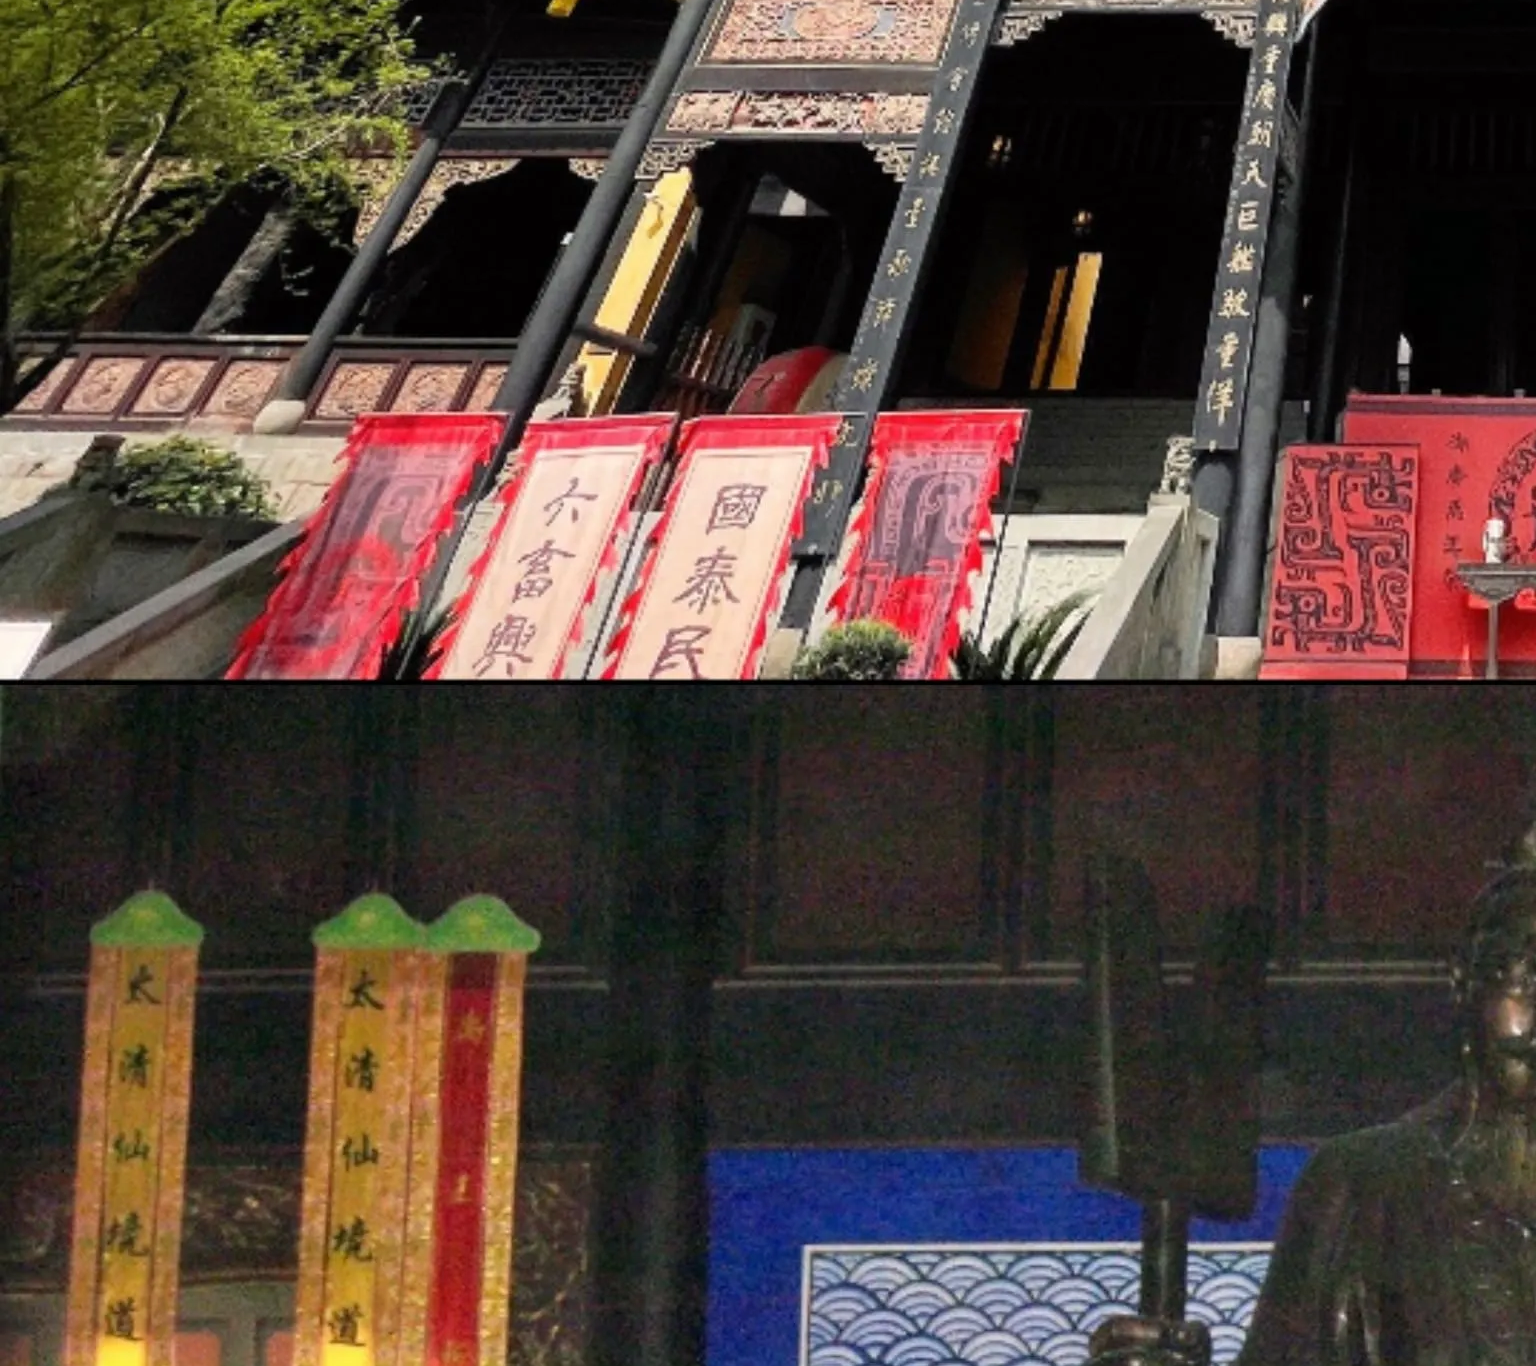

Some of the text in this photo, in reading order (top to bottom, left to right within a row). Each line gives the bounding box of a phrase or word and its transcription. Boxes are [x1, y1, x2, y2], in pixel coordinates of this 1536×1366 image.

[472, 476, 599, 678] 六畜興
[649, 483, 768, 680] 國泰民
